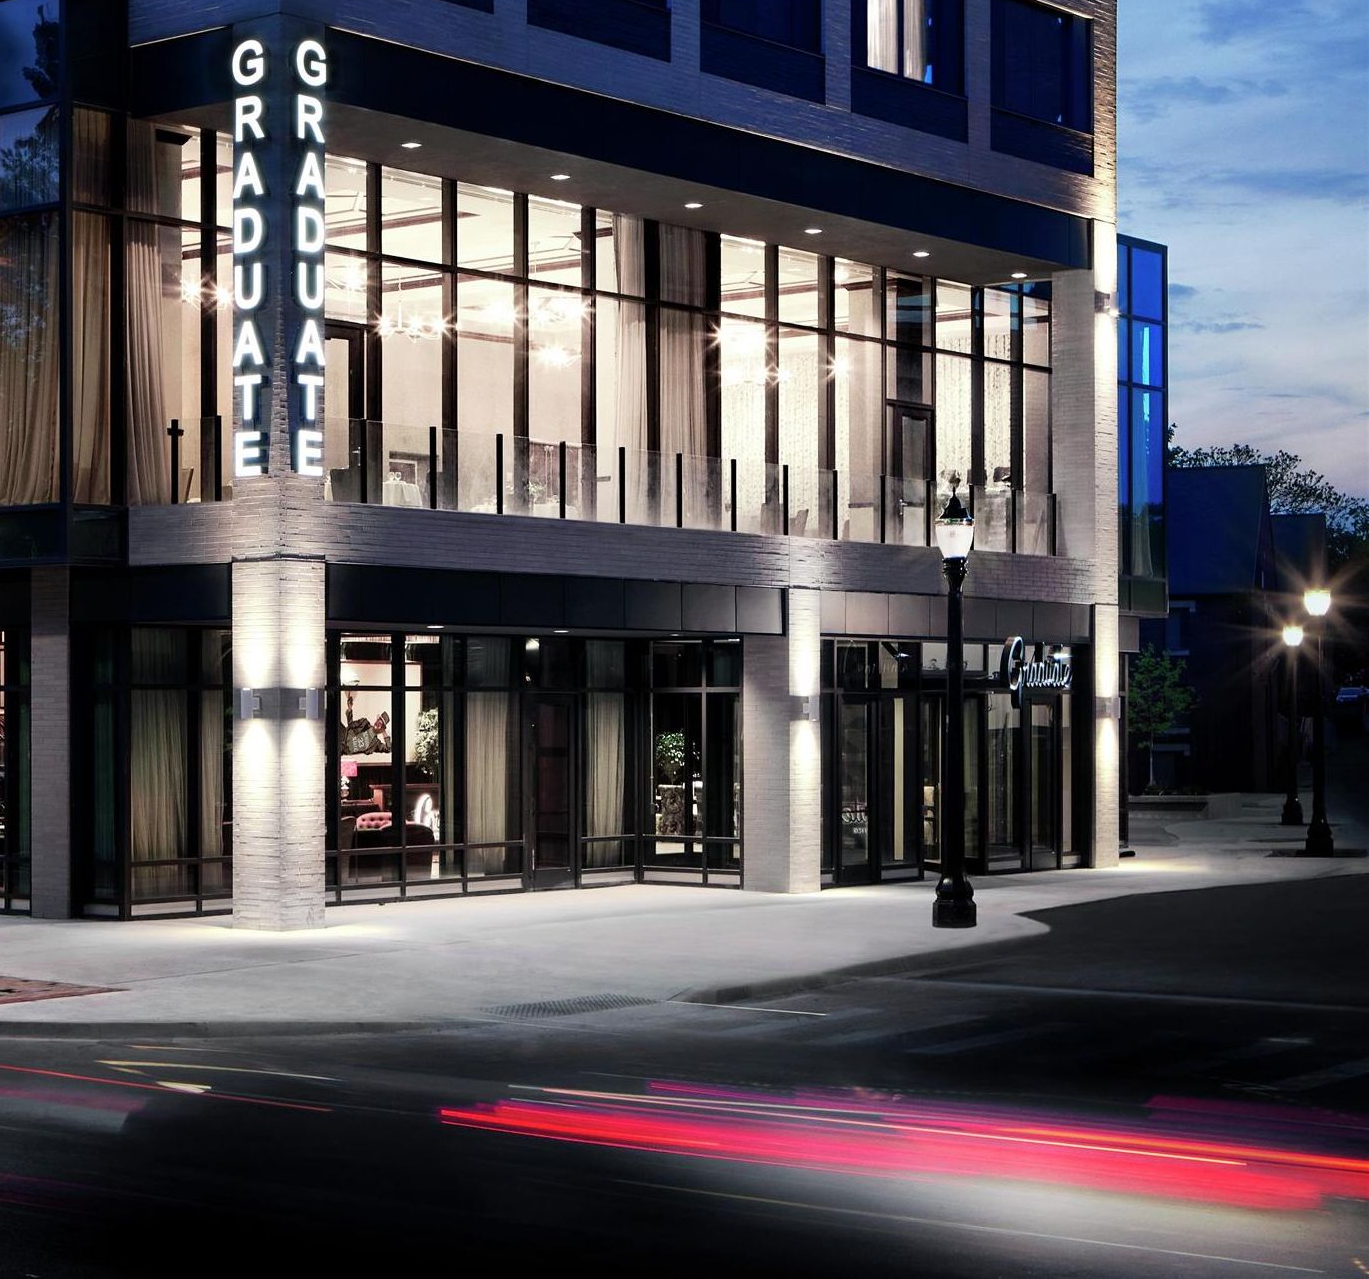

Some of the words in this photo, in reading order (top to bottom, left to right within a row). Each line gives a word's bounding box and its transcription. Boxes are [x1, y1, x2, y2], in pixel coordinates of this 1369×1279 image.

[232, 40, 265, 477] GRADUATE
[295, 40, 327, 477] GRADUATE
[1007, 636, 1073, 708] Graduate
